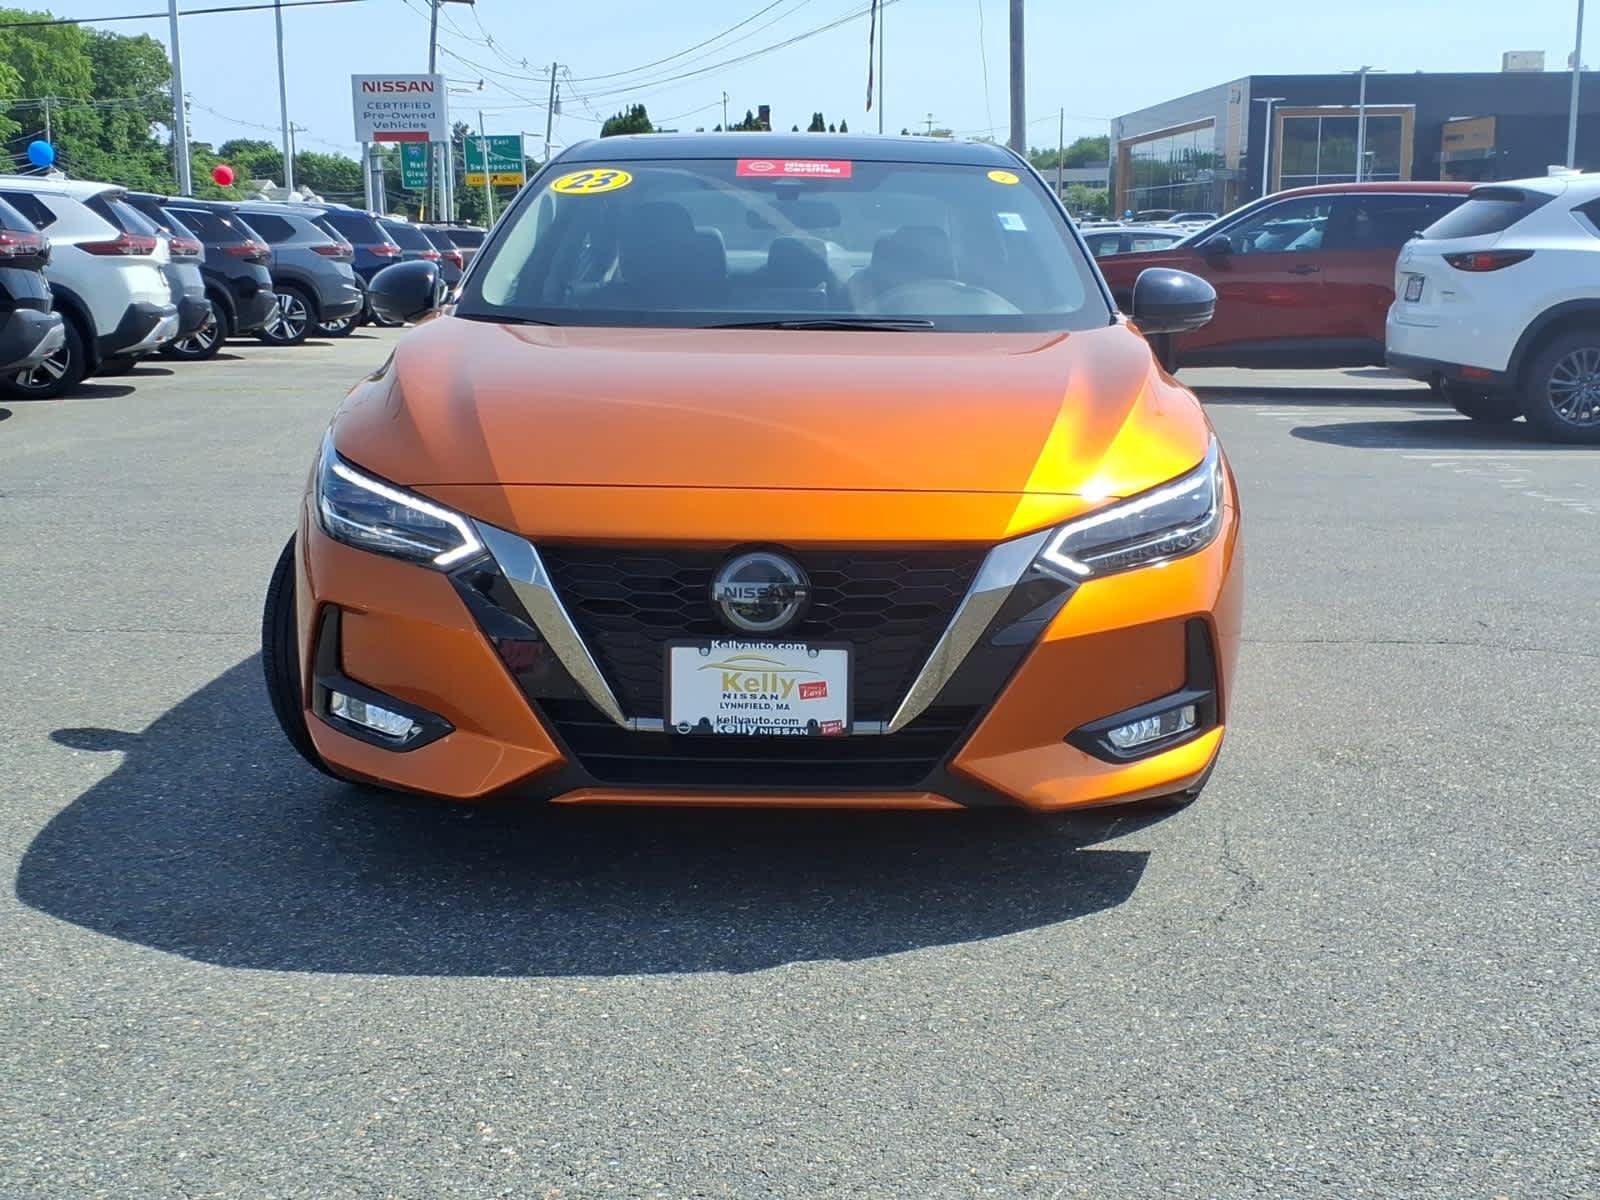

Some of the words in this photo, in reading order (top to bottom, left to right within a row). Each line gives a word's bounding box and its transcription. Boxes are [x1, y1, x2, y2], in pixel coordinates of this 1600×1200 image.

[362, 81, 434, 92] NISSAN
[367, 102, 431, 110] CERTIFIED
[373, 121, 427, 129] Vehicles
[561, 172, 618, 190] 23
[723, 587, 795, 600] NISSAN
[711, 640, 807, 650] Kellyauto.com
[721, 672, 796, 700] Kelly
[719, 703, 774, 711] LYNNFIELD,
[716, 715, 799, 726] kellyauto.com
[713, 723, 759, 736] Kelly
[760, 727, 808, 735] NISSAN
